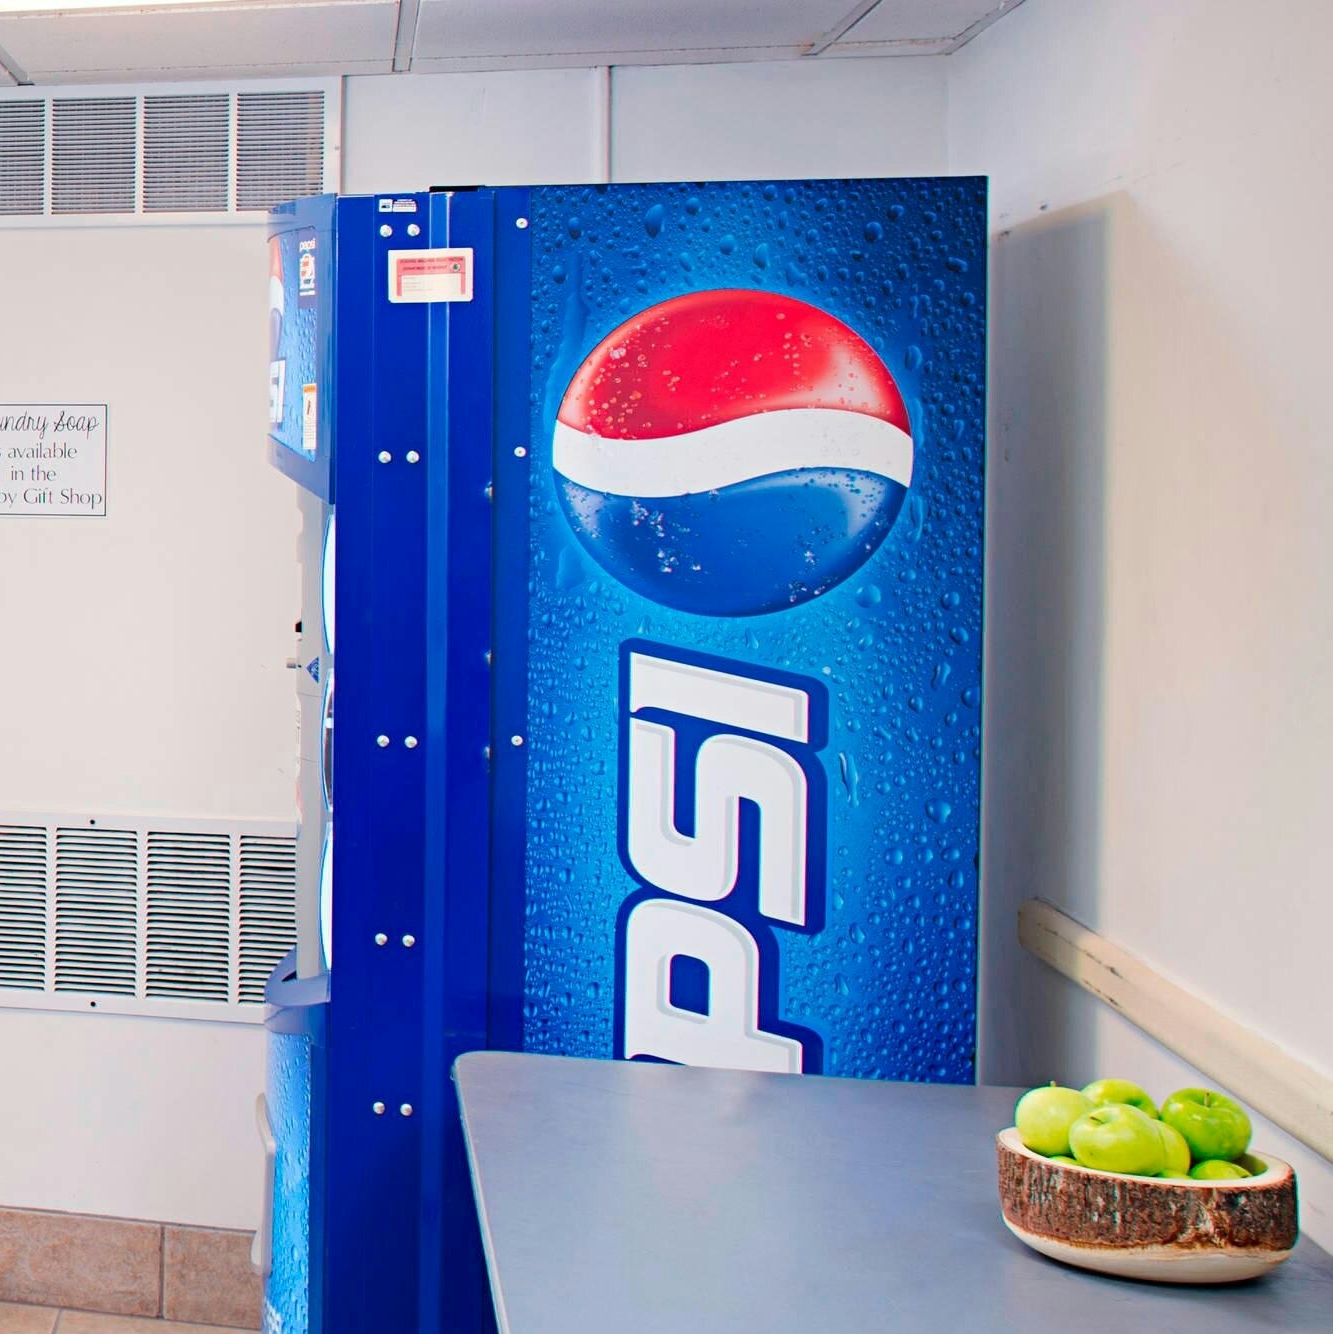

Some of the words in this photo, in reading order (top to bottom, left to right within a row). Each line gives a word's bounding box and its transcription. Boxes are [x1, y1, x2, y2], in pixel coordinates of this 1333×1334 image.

[54, 410, 99, 440] Soap
[7, 442, 78, 459] available
[11, 465, 24, 481] in
[30, 464, 57, 481] the
[23, 488, 53, 504] Gift
[61, 488, 102, 509] Shop
[624, 652, 809, 1074] PSI
